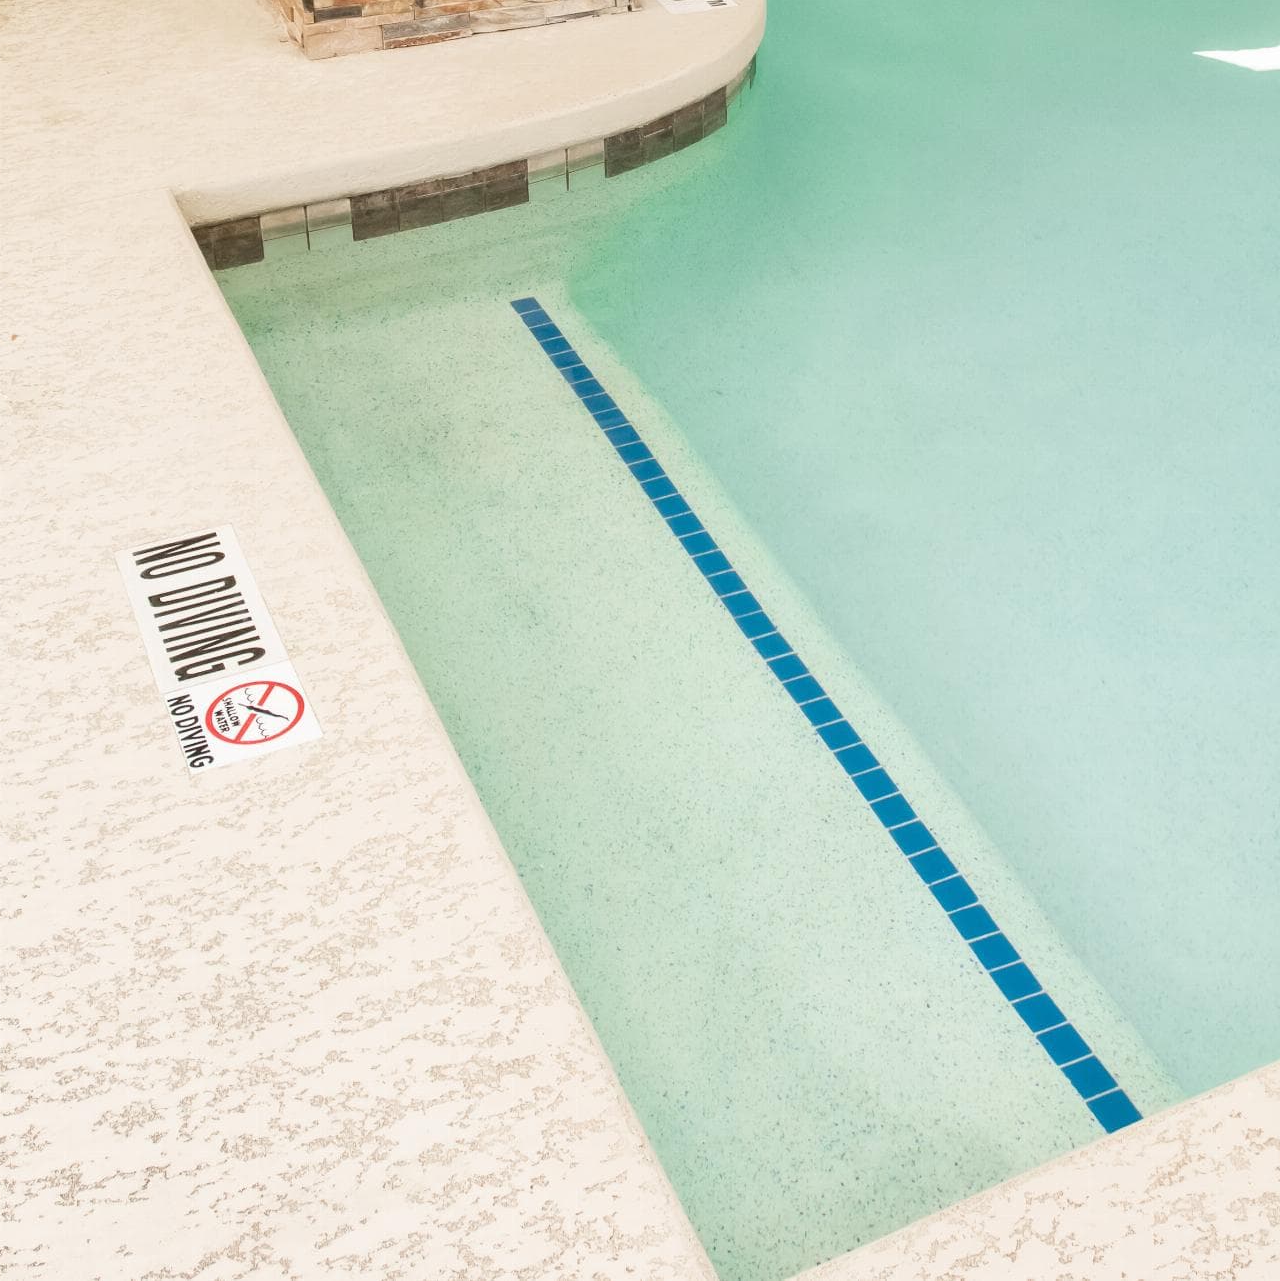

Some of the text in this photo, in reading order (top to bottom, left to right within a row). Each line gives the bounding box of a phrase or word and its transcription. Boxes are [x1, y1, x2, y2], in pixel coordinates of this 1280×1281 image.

[132, 531, 266, 682] NO DIVING
[167, 693, 215, 769] NO DIVING
[214, 709, 231, 734] WATER
[222, 697, 241, 728] SHALLOW
